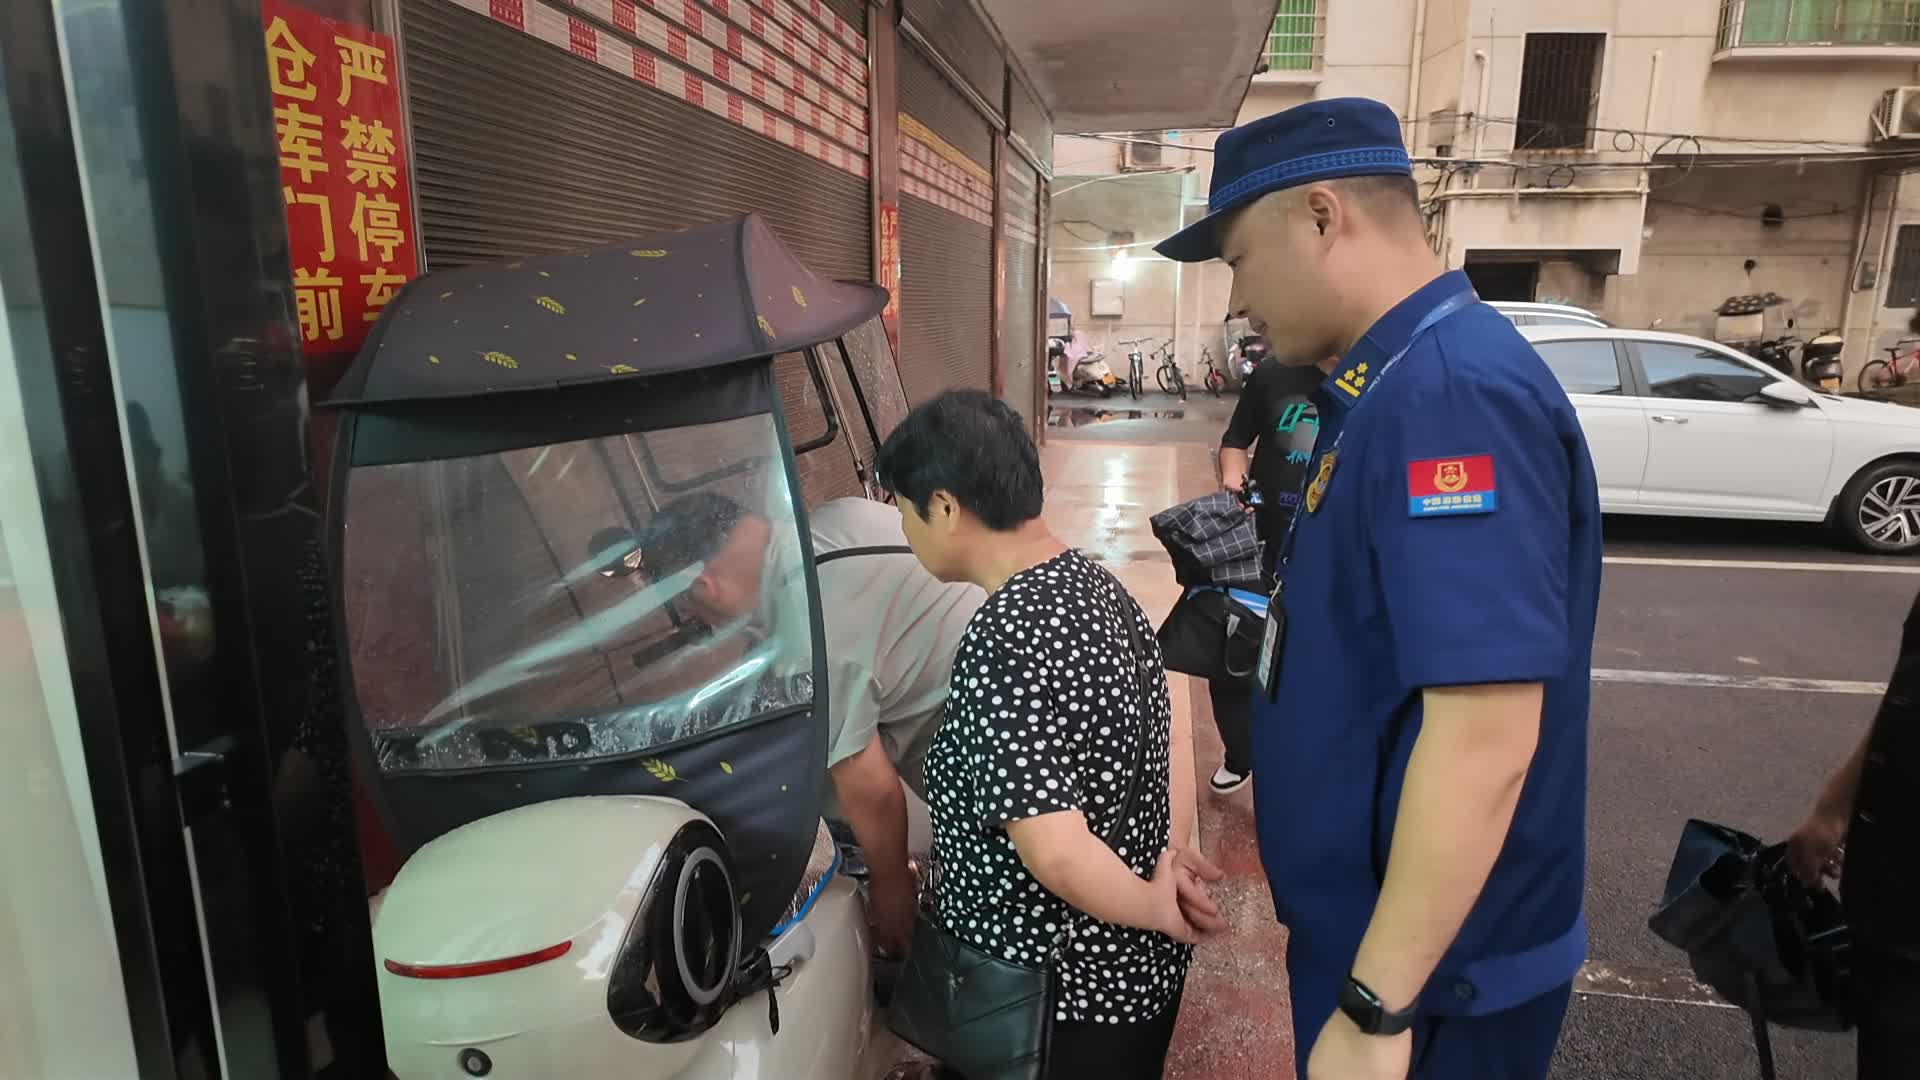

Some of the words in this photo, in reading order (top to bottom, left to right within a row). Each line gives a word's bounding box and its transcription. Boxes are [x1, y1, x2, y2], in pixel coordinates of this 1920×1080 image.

[265, 15, 344, 341] 仓库门前
[334, 35, 407, 321] 严禁停车
